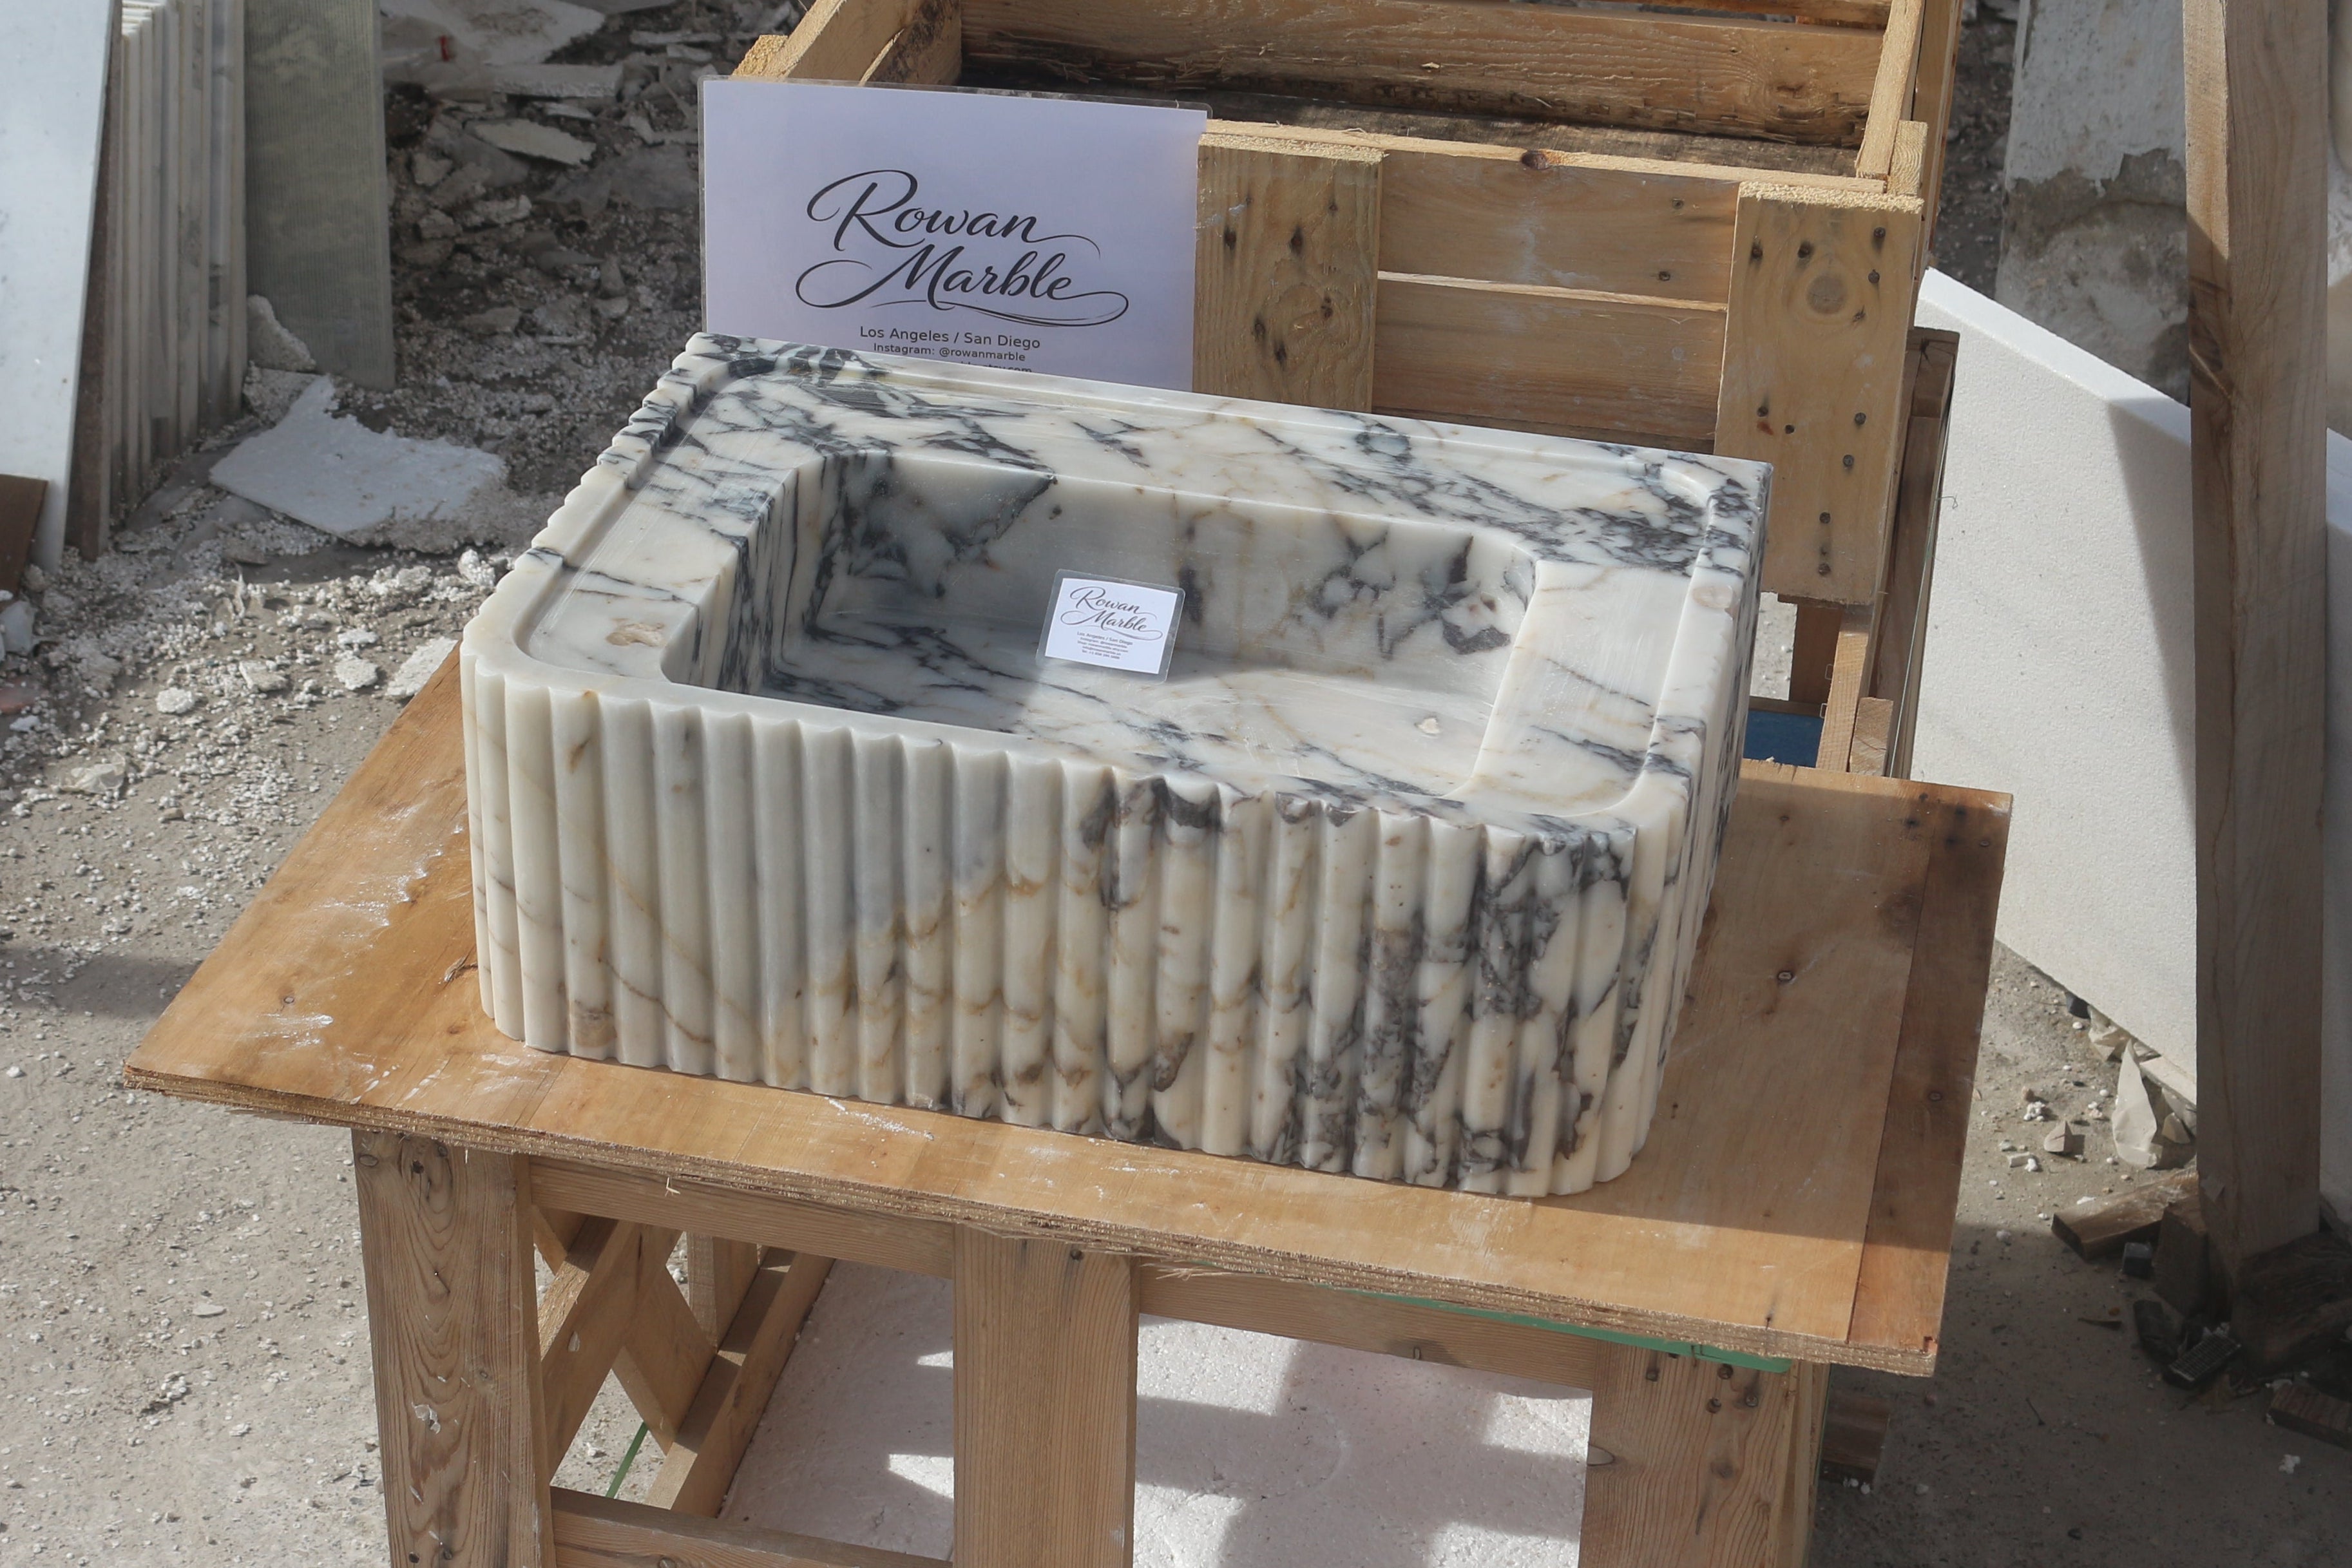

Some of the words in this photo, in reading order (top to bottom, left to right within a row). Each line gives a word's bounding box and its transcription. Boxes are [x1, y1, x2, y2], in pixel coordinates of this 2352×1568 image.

[807, 169, 1101, 259] Rowan
[796, 244, 1129, 327] Marble
[860, 326, 884, 338] Los
[890, 328, 950, 343] Angeles
[953, 332, 959, 343] /
[964, 332, 991, 345] San
[998, 334, 1040, 350] Diego
[874, 343, 935, 356] Instagram:
[939, 347, 1026, 361] @rowanmarble
[1070, 586, 1157, 620] Rowan
[1060, 610, 1163, 640] Marble
